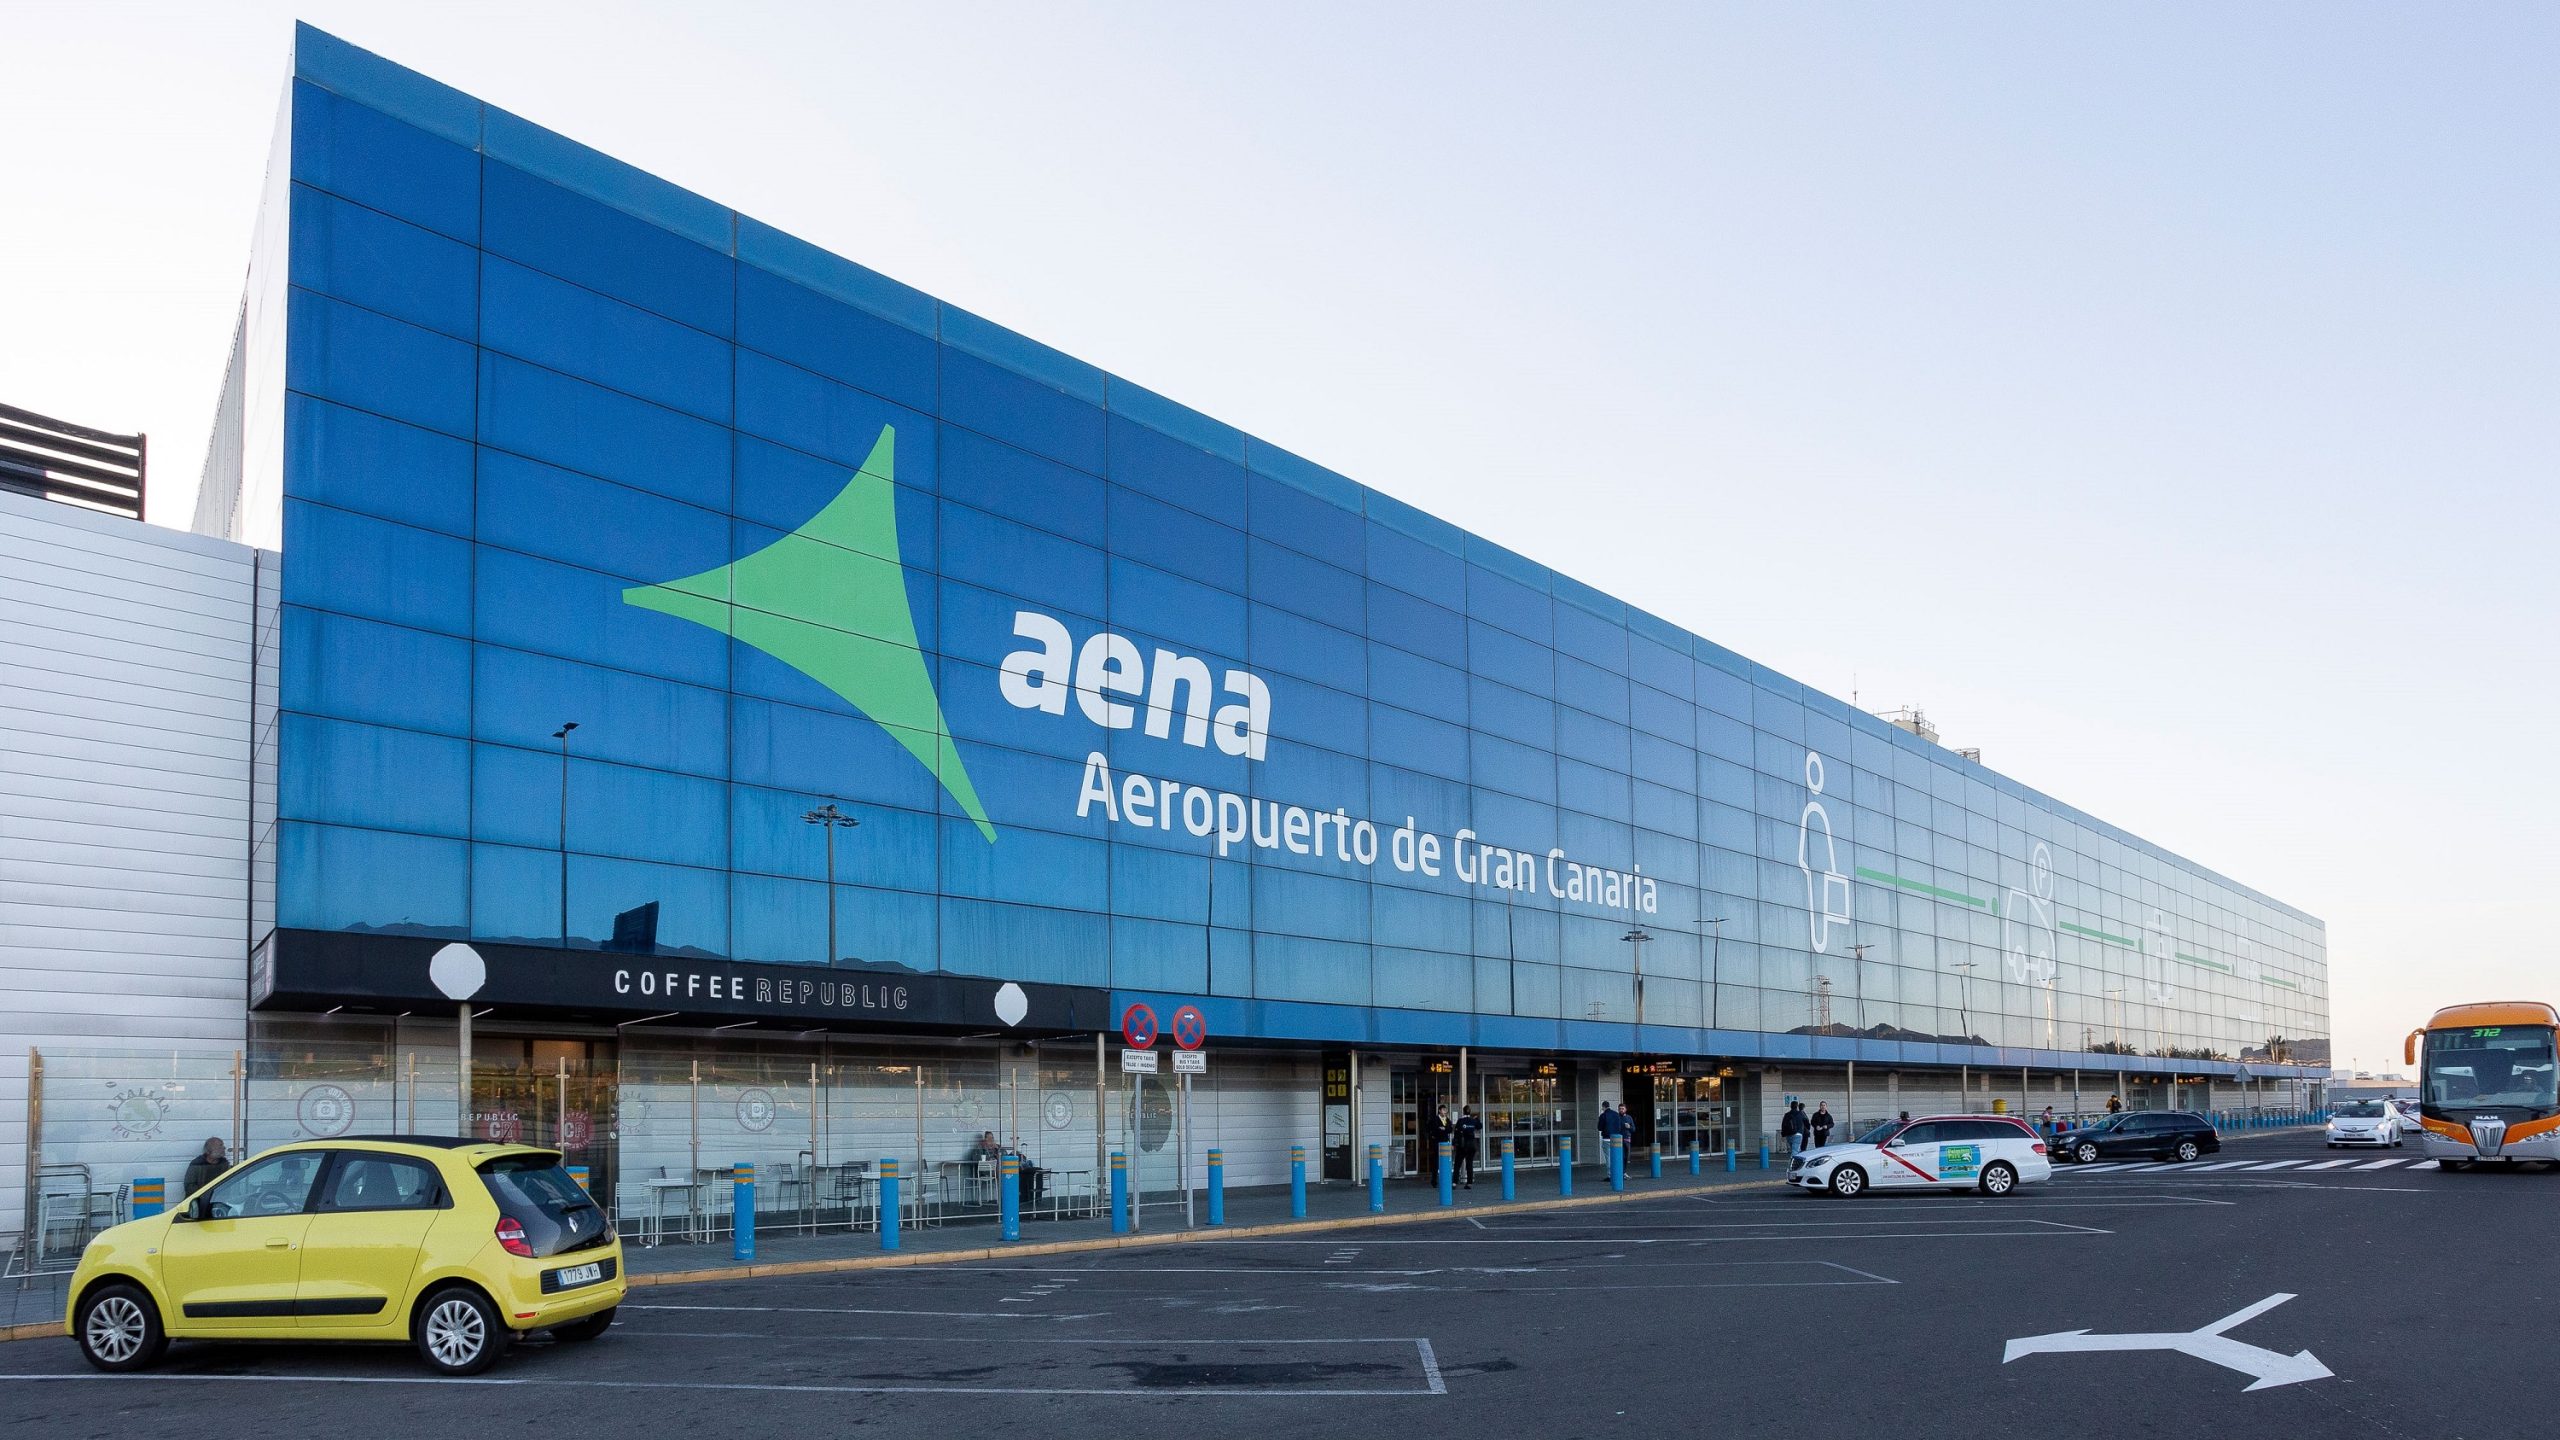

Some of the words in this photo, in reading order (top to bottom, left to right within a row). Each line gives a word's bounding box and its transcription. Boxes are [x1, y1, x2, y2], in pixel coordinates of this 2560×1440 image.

[1000, 611, 1271, 761] aena
[1076, 751, 1378, 866] Aeropuerto
[1392, 816, 1441, 877] de
[1455, 829, 1536, 894] Gran
[1547, 848, 1658, 914] Canaria
[2039, 858, 2047, 889] P
[614, 970, 744, 1000] COFFEE
[756, 977, 908, 1010] REPUBLIC
[2470, 1028, 2501, 1038] 312
[460, 1113, 519, 1121] REPUBLIC
[489, 1121, 514, 1138] CR
[564, 1122, 586, 1138] CR
[563, 1268, 584, 1283] 1779
